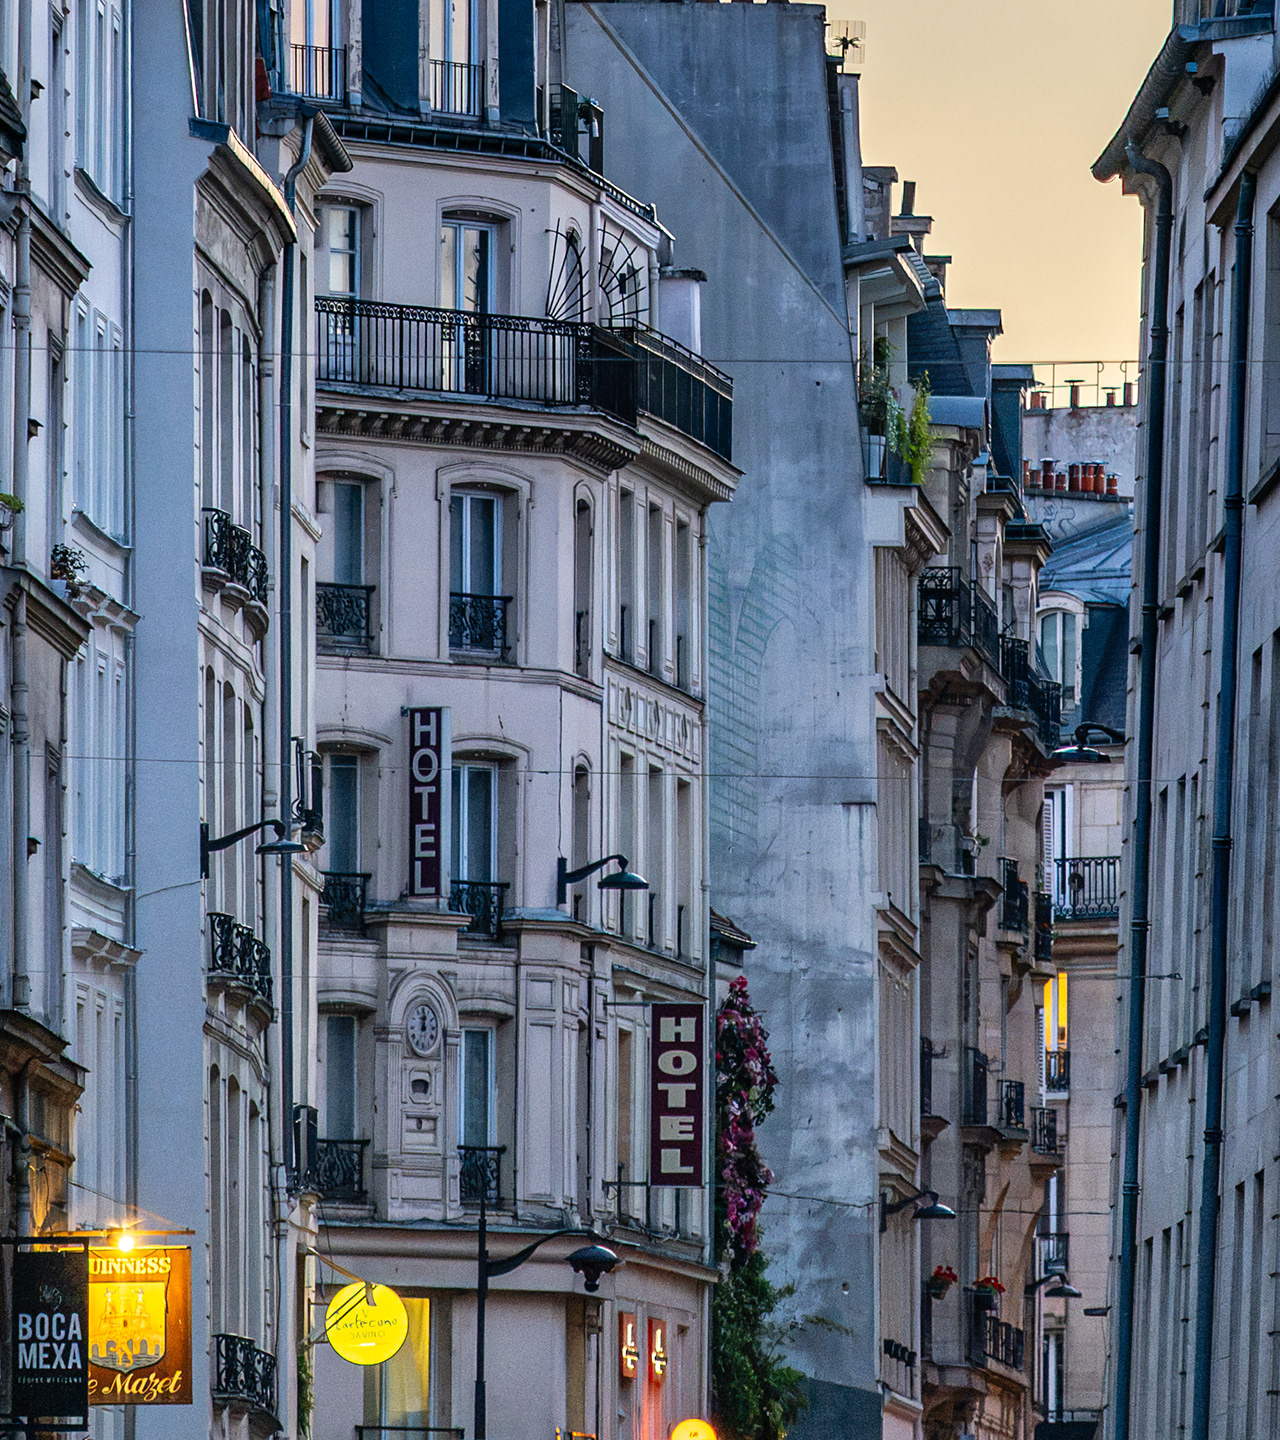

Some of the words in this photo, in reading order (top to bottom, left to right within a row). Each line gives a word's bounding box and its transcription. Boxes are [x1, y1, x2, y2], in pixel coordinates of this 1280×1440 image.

[412, 711, 438, 894] HOTEL
[657, 1016, 698, 1174] HOTEL
[88, 1257, 171, 1275] UINNESS
[18, 1313, 82, 1341] BOCA
[18, 1342, 82, 1369] MEXA
[102, 1370, 182, 1402] Mazet
